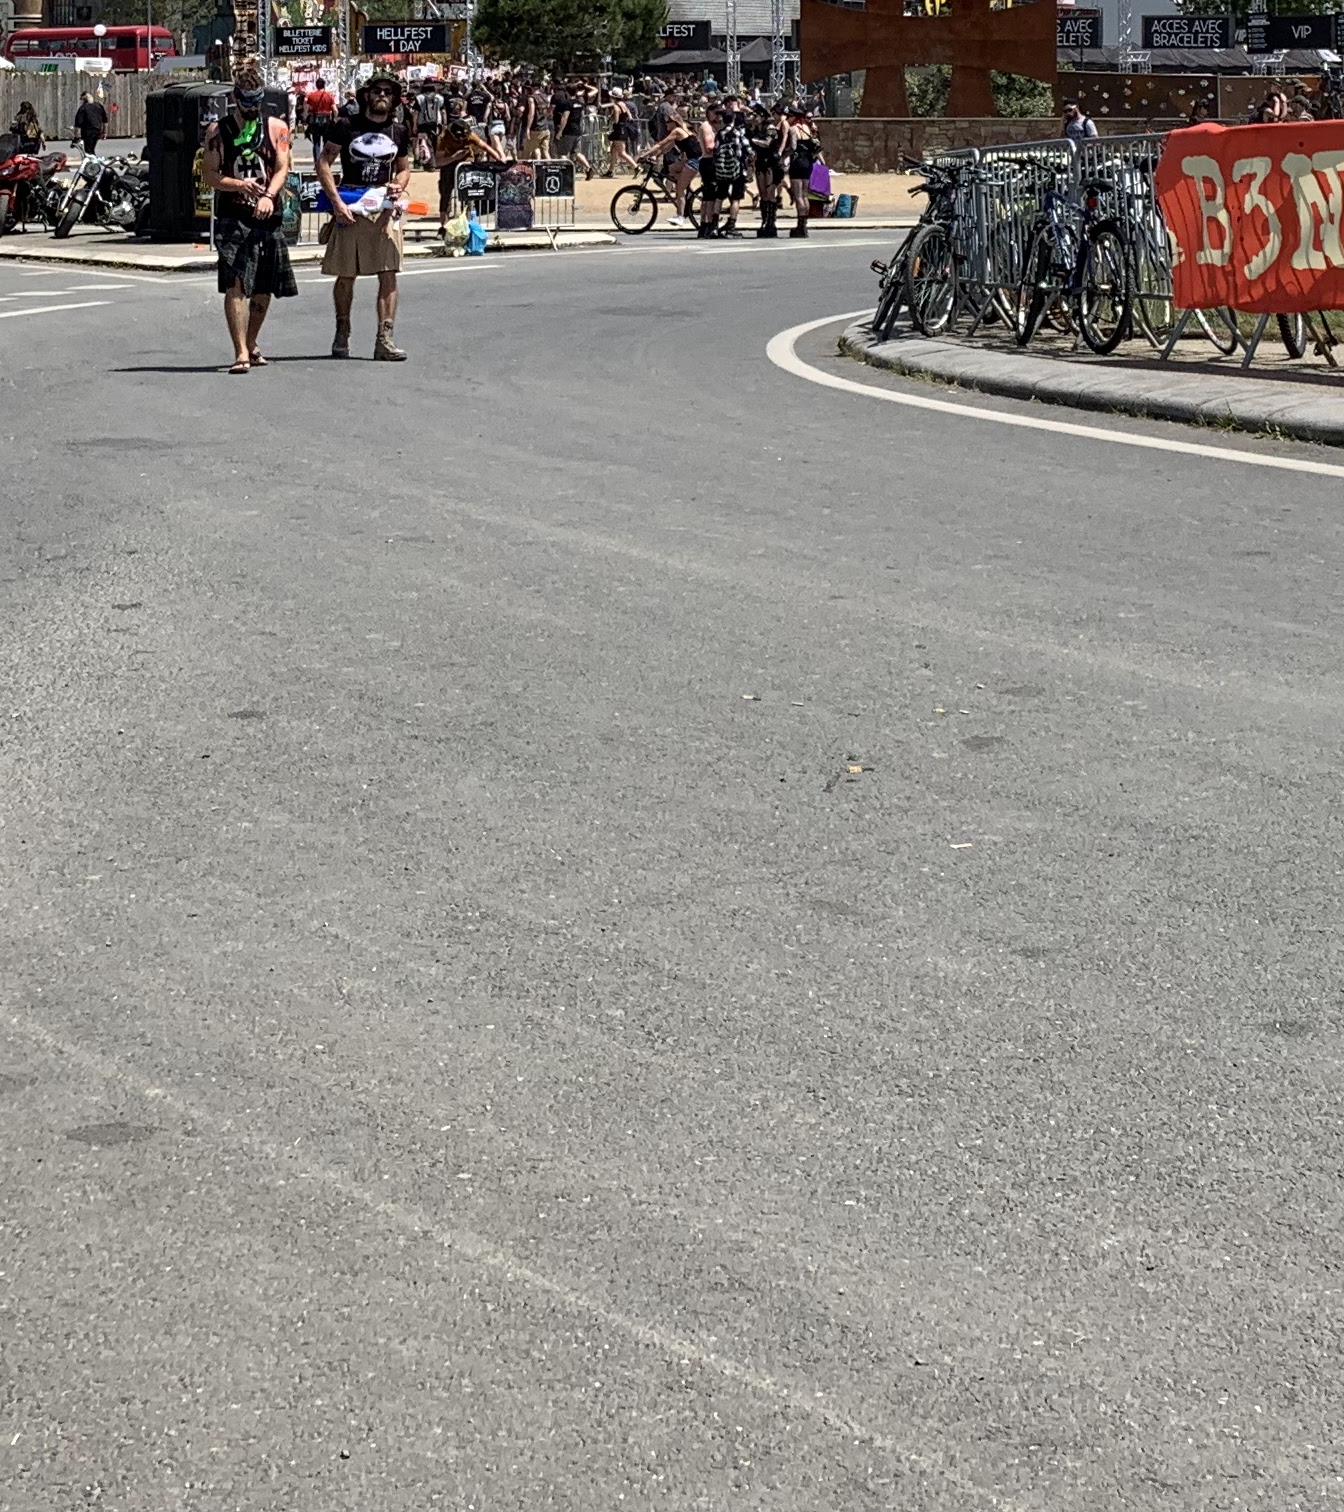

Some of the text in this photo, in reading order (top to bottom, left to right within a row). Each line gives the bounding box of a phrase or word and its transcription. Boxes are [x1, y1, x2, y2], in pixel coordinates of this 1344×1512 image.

[1065, 20, 1093, 33] AVEC
[1151, 19, 1223, 34] ACCES AVEC
[1291, 26, 1312, 39] VIP
[377, 27, 433, 40] HELLFEST
[1153, 32, 1220, 47] BRACELETS
[292, 37, 314, 45] TICKET
[399, 41, 422, 52] DAY
[278, 44, 327, 53] HELLFEST KIDS
